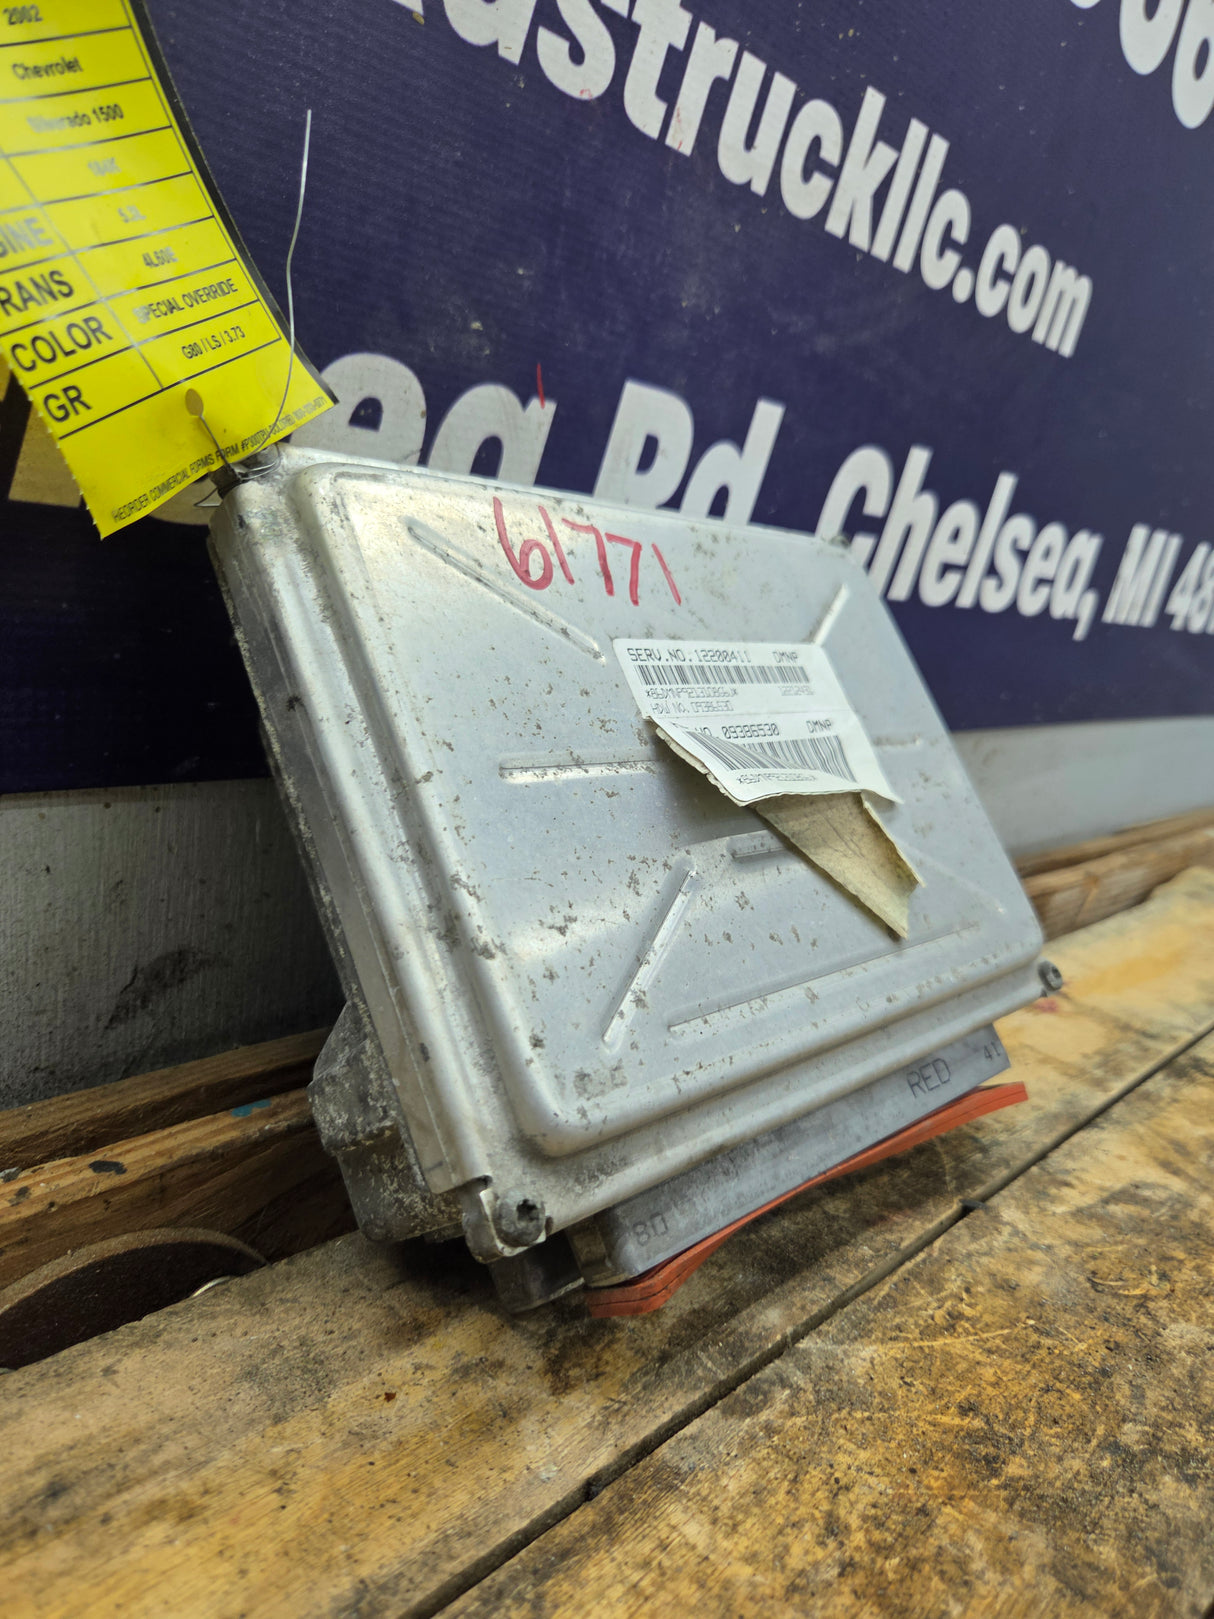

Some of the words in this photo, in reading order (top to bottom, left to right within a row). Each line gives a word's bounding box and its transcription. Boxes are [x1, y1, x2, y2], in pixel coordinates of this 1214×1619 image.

[3, 4, 43, 26] 2002
[11, 56, 83, 80] Chevrolet
[92, 103, 124, 123] 1500
[392, 0, 1093, 358] struckllc.com
[132, 297, 185, 324] SPECIAL
[181, 278, 239, 309] OVERRIDE
[10, 316, 113, 373] COLOR
[43, 385, 92, 422] GR
[492, 496, 682, 607] 61771
[815, 444, 1104, 642] Chelsea,
[1101, 522, 1184, 629] MI
[1164, 541, 1214, 636] 48
[722, 723, 780, 739] 09386530
[805, 718, 833, 734] DMNP
[905, 1057, 952, 1099] RED
